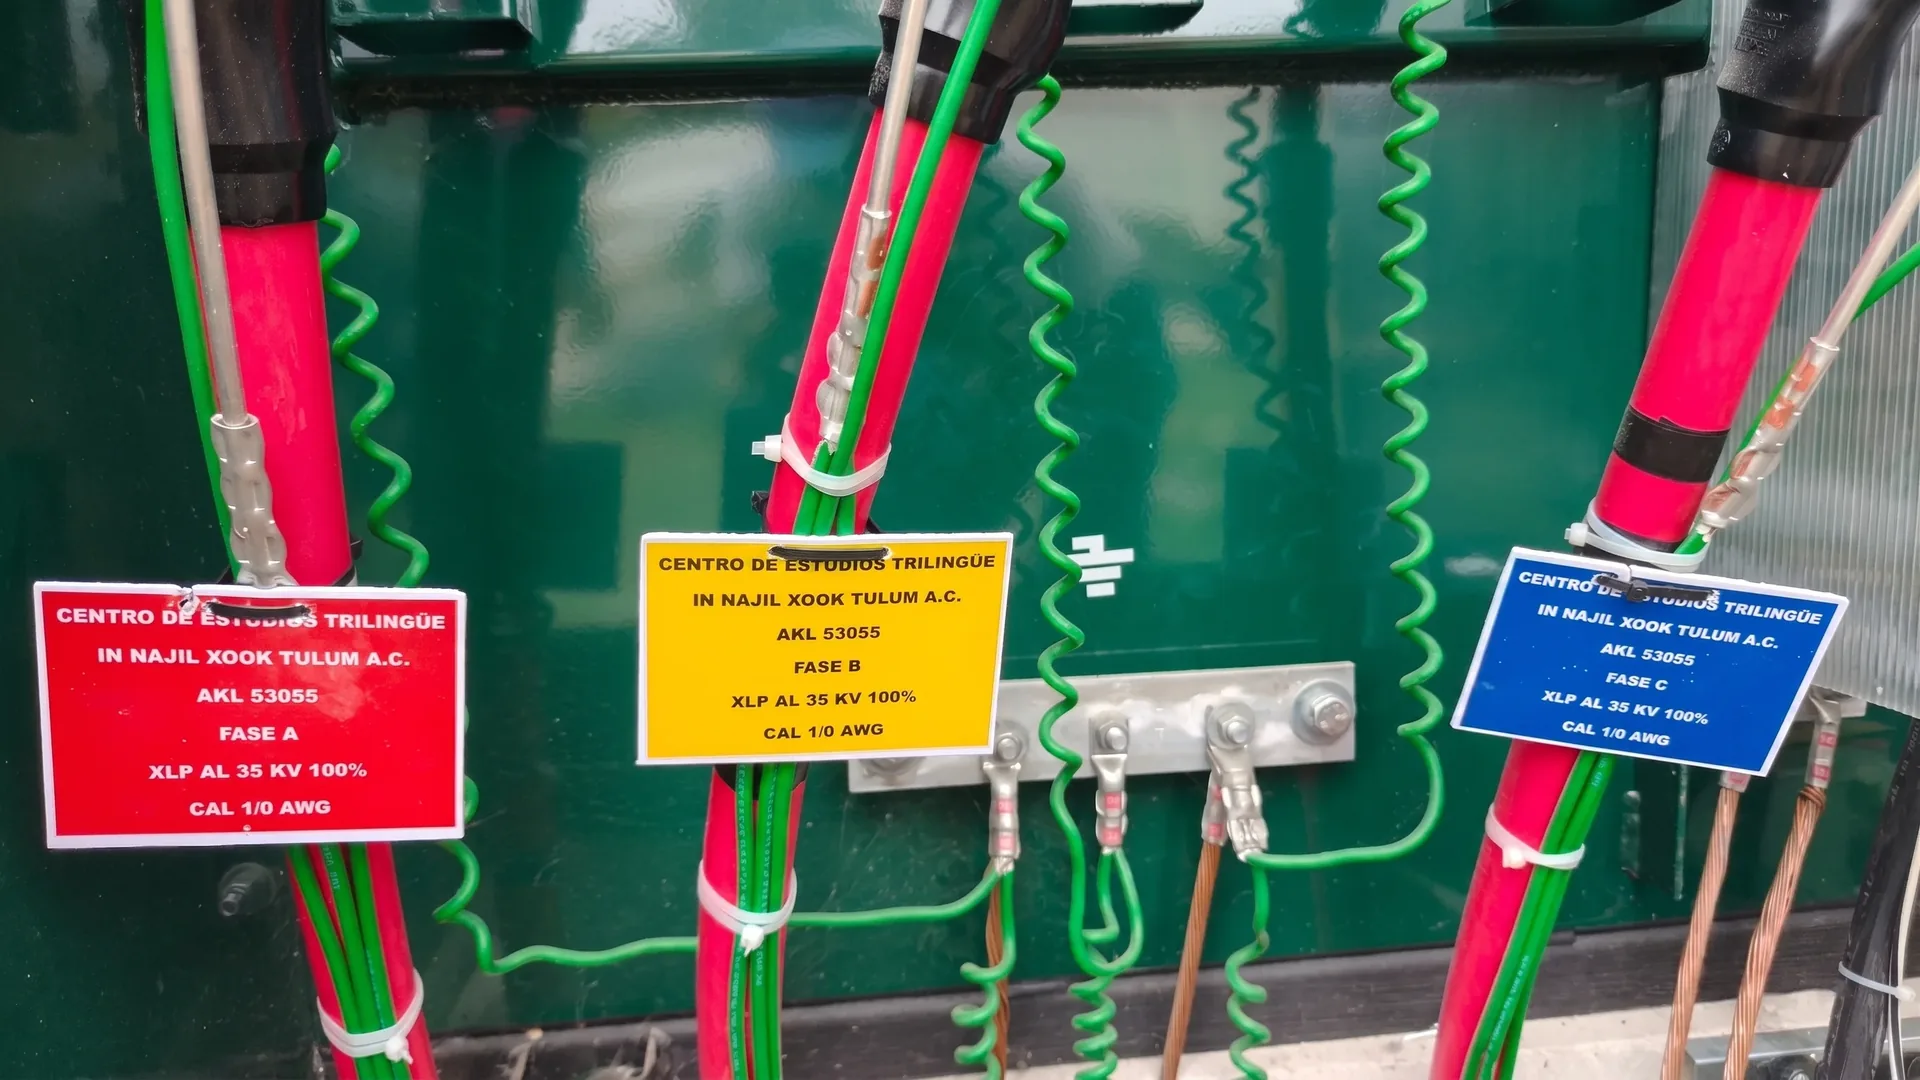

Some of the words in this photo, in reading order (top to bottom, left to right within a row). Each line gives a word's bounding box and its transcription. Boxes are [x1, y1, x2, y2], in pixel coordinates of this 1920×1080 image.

[659, 558, 744, 570] CENTRO
[752, 558, 778, 571] DE
[785, 559, 885, 571] ESTUDIOS
[892, 553, 995, 569] TRILINGÜE
[694, 594, 713, 606] IN
[722, 594, 780, 606] NAJIL
[788, 594, 844, 606] XOOK
[852, 592, 917, 604] TULUM
[925, 591, 960, 602] A.C.
[1518, 571, 1594, 592] CENTRO
[1598, 584, 1620, 598] DE
[1724, 601, 1823, 626] TRILINGÜE
[57, 608, 154, 624] CENTRO
[162, 608, 193, 625] DE
[324, 612, 446, 630] TRILINGÜE
[1538, 604, 1558, 616] IN
[1562, 608, 1614, 625] NAJIL
[1619, 617, 1673, 634] XOOK
[1678, 625, 1740, 643] TULUM
[1743, 635, 1778, 648] A.C.
[777, 628, 816, 640] AKL
[824, 627, 880, 639] 53055
[98, 648, 122, 662] IN
[131, 649, 199, 663] NAJIL
[207, 650, 273, 665] XOOK
[279, 651, 359, 666] TULUM
[366, 652, 410, 666] A.C.
[1600, 643, 1636, 657] AKL
[1642, 649, 1695, 666] 53055
[795, 661, 841, 673] FASE
[849, 660, 860, 671] B
[1606, 673, 1651, 688] FASE
[1655, 680, 1668, 690] C
[197, 689, 244, 703] AKL
[251, 689, 318, 703] 53055
[732, 696, 768, 707] XLP
[776, 696, 799, 707] AL
[807, 694, 828, 706] 35
[836, 693, 861, 704] KV
[869, 691, 916, 703] 100%
[1542, 691, 1576, 704] XLP
[1580, 697, 1602, 709] AL
[1608, 701, 1629, 712] 35
[1633, 704, 1660, 716] KV
[1665, 709, 1708, 724] 100%
[220, 727, 275, 740] FASE
[283, 727, 298, 740] A
[764, 728, 801, 739] CAL
[809, 726, 834, 737] 1/0
[841, 724, 883, 736] AWG
[1562, 721, 1595, 735] CAL
[1602, 727, 1626, 739] 1/0
[1629, 732, 1670, 745] AWG
[149, 765, 193, 779] XLP
[200, 765, 229, 778] AL
[237, 764, 262, 778] 35
[271, 764, 302, 777] KV
[309, 763, 367, 777] 100%
[190, 802, 234, 816] CAL
[242, 801, 273, 815] 1/0
[280, 800, 330, 814] AWG
